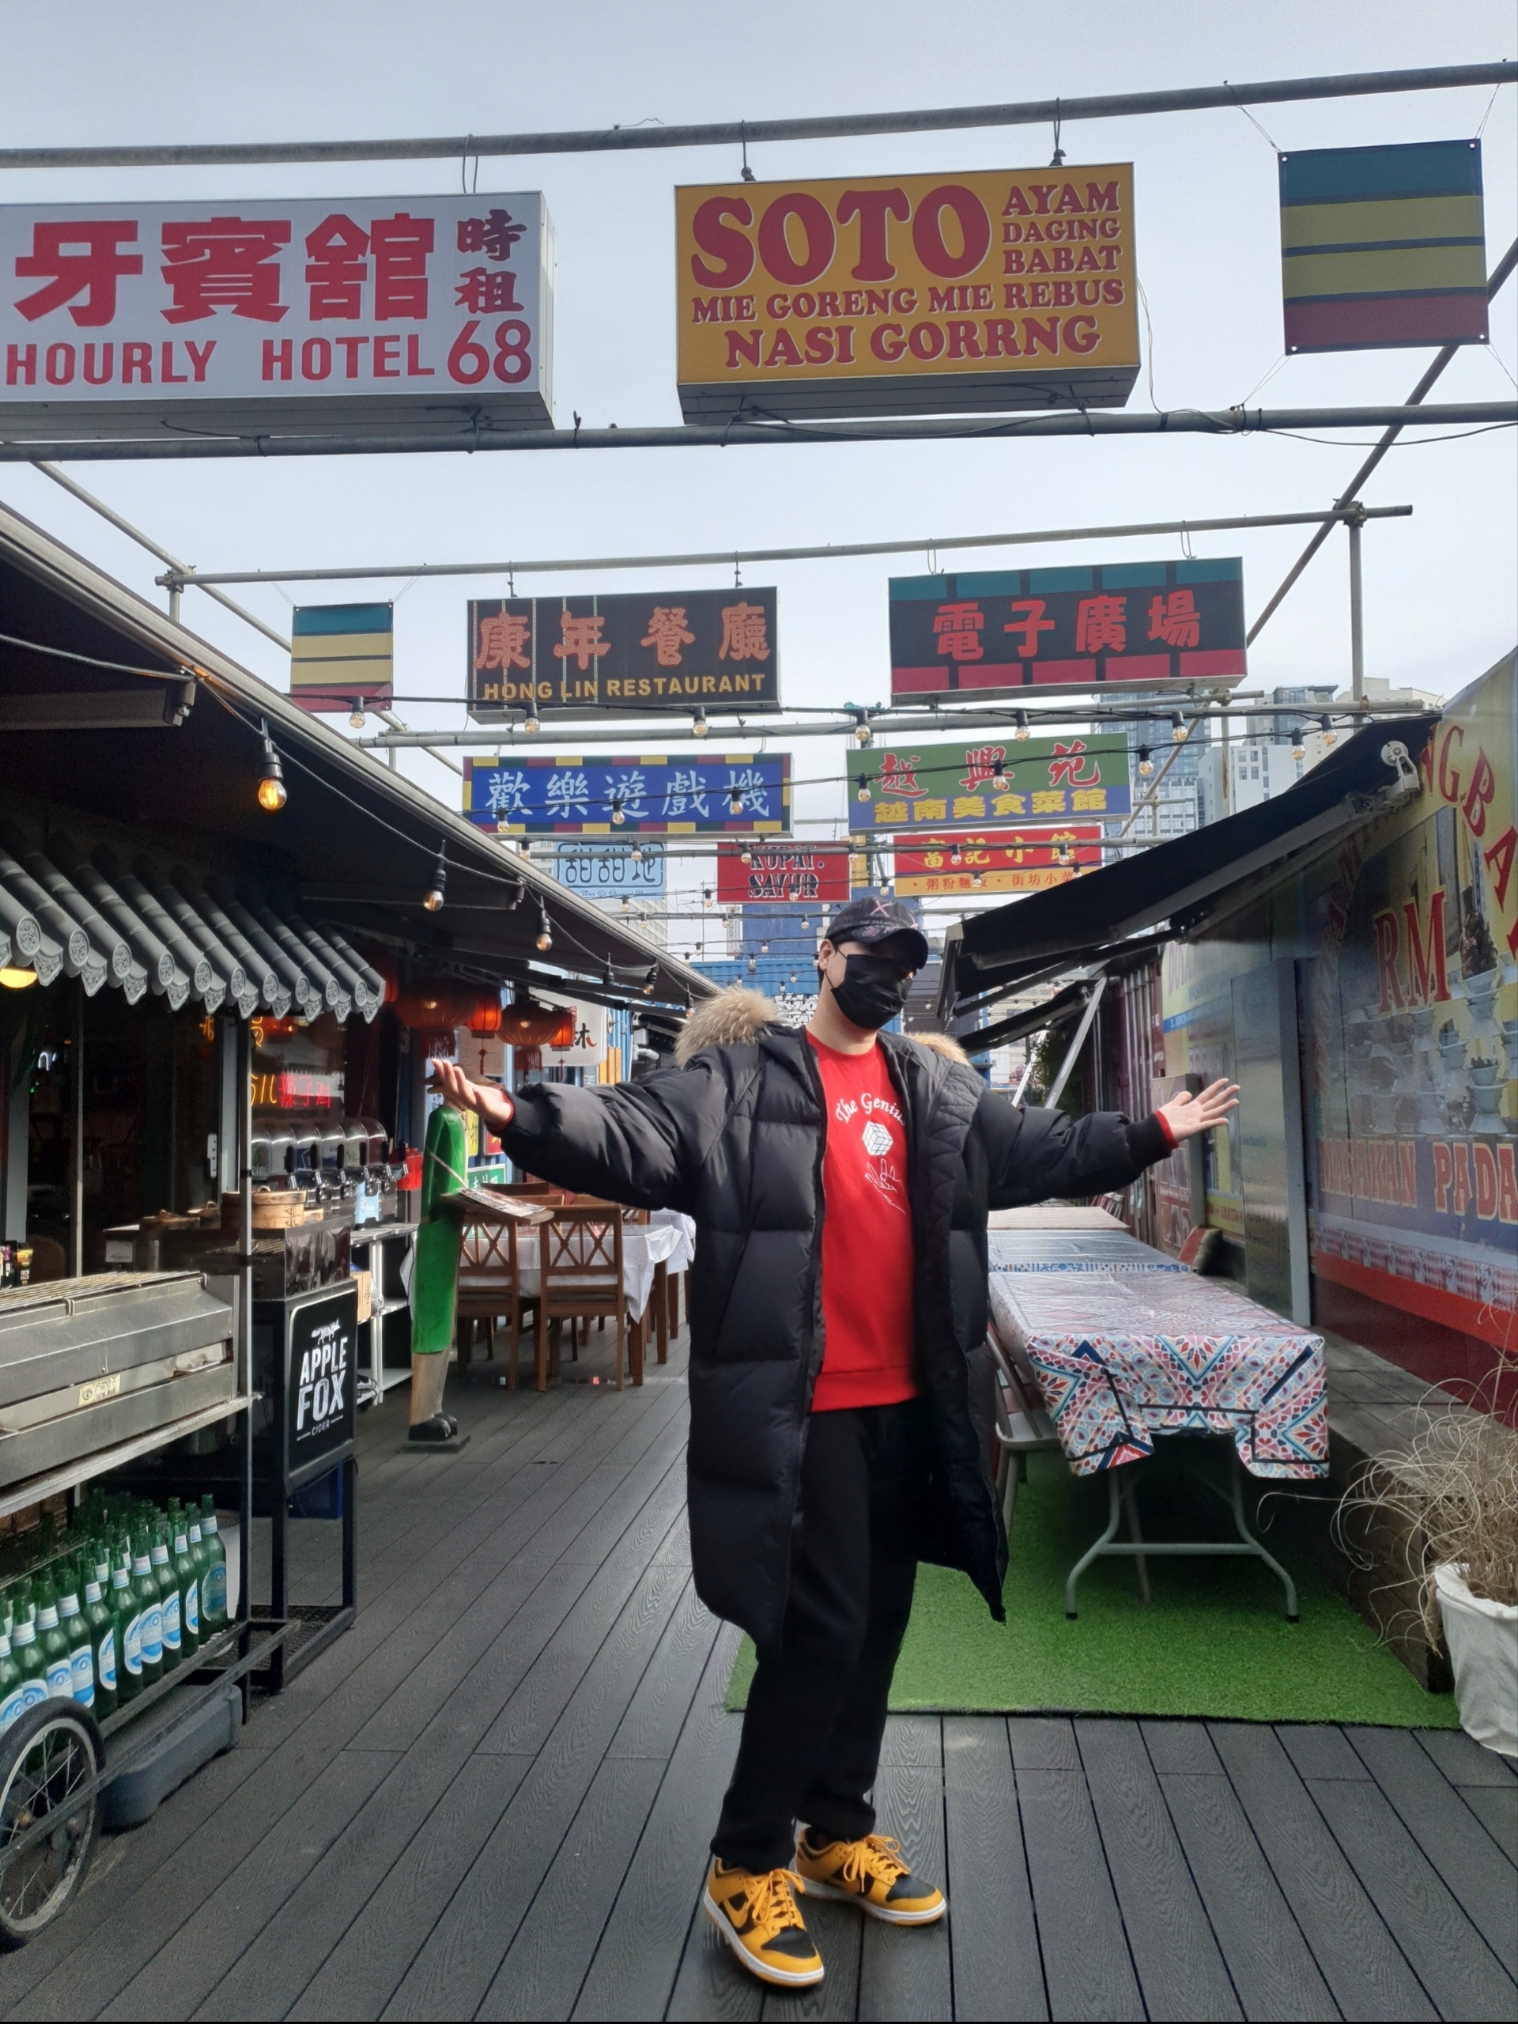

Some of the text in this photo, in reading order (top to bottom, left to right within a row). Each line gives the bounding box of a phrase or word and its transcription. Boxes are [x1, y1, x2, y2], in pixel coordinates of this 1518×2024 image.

[1001, 181, 1121, 218] AYAM
[691, 185, 992, 290] SOTO
[1002, 218, 1121, 245] DAGING
[455, 208, 528, 314] 時租
[1002, 244, 1122, 276] BABAT
[692, 279, 1124, 324] MIE GORENG MIE REBUS
[5, 334, 435, 386] HOURLY HOTEL
[446, 319, 532, 385] 68
[725, 314, 1101, 370] NASI GORRNG
[474, 602, 770, 670] 康年餐廳
[932, 590, 1200, 661] 電子廣場
[484, 674, 765, 700] HONG LIN RESTAURANT
[485, 769, 770, 818] 歡樂遊戲機
[874, 788, 1107, 823] 越南美食菜館
[748, 873, 818, 898] SAYUR
[1374, 890, 1451, 1015] RM
[836, 1093, 905, 1126] The Geniu
[300, 1337, 348, 1386] APPLE
[297, 1370, 346, 1431] FOX
[311, 1420, 330, 1436] CIDER
